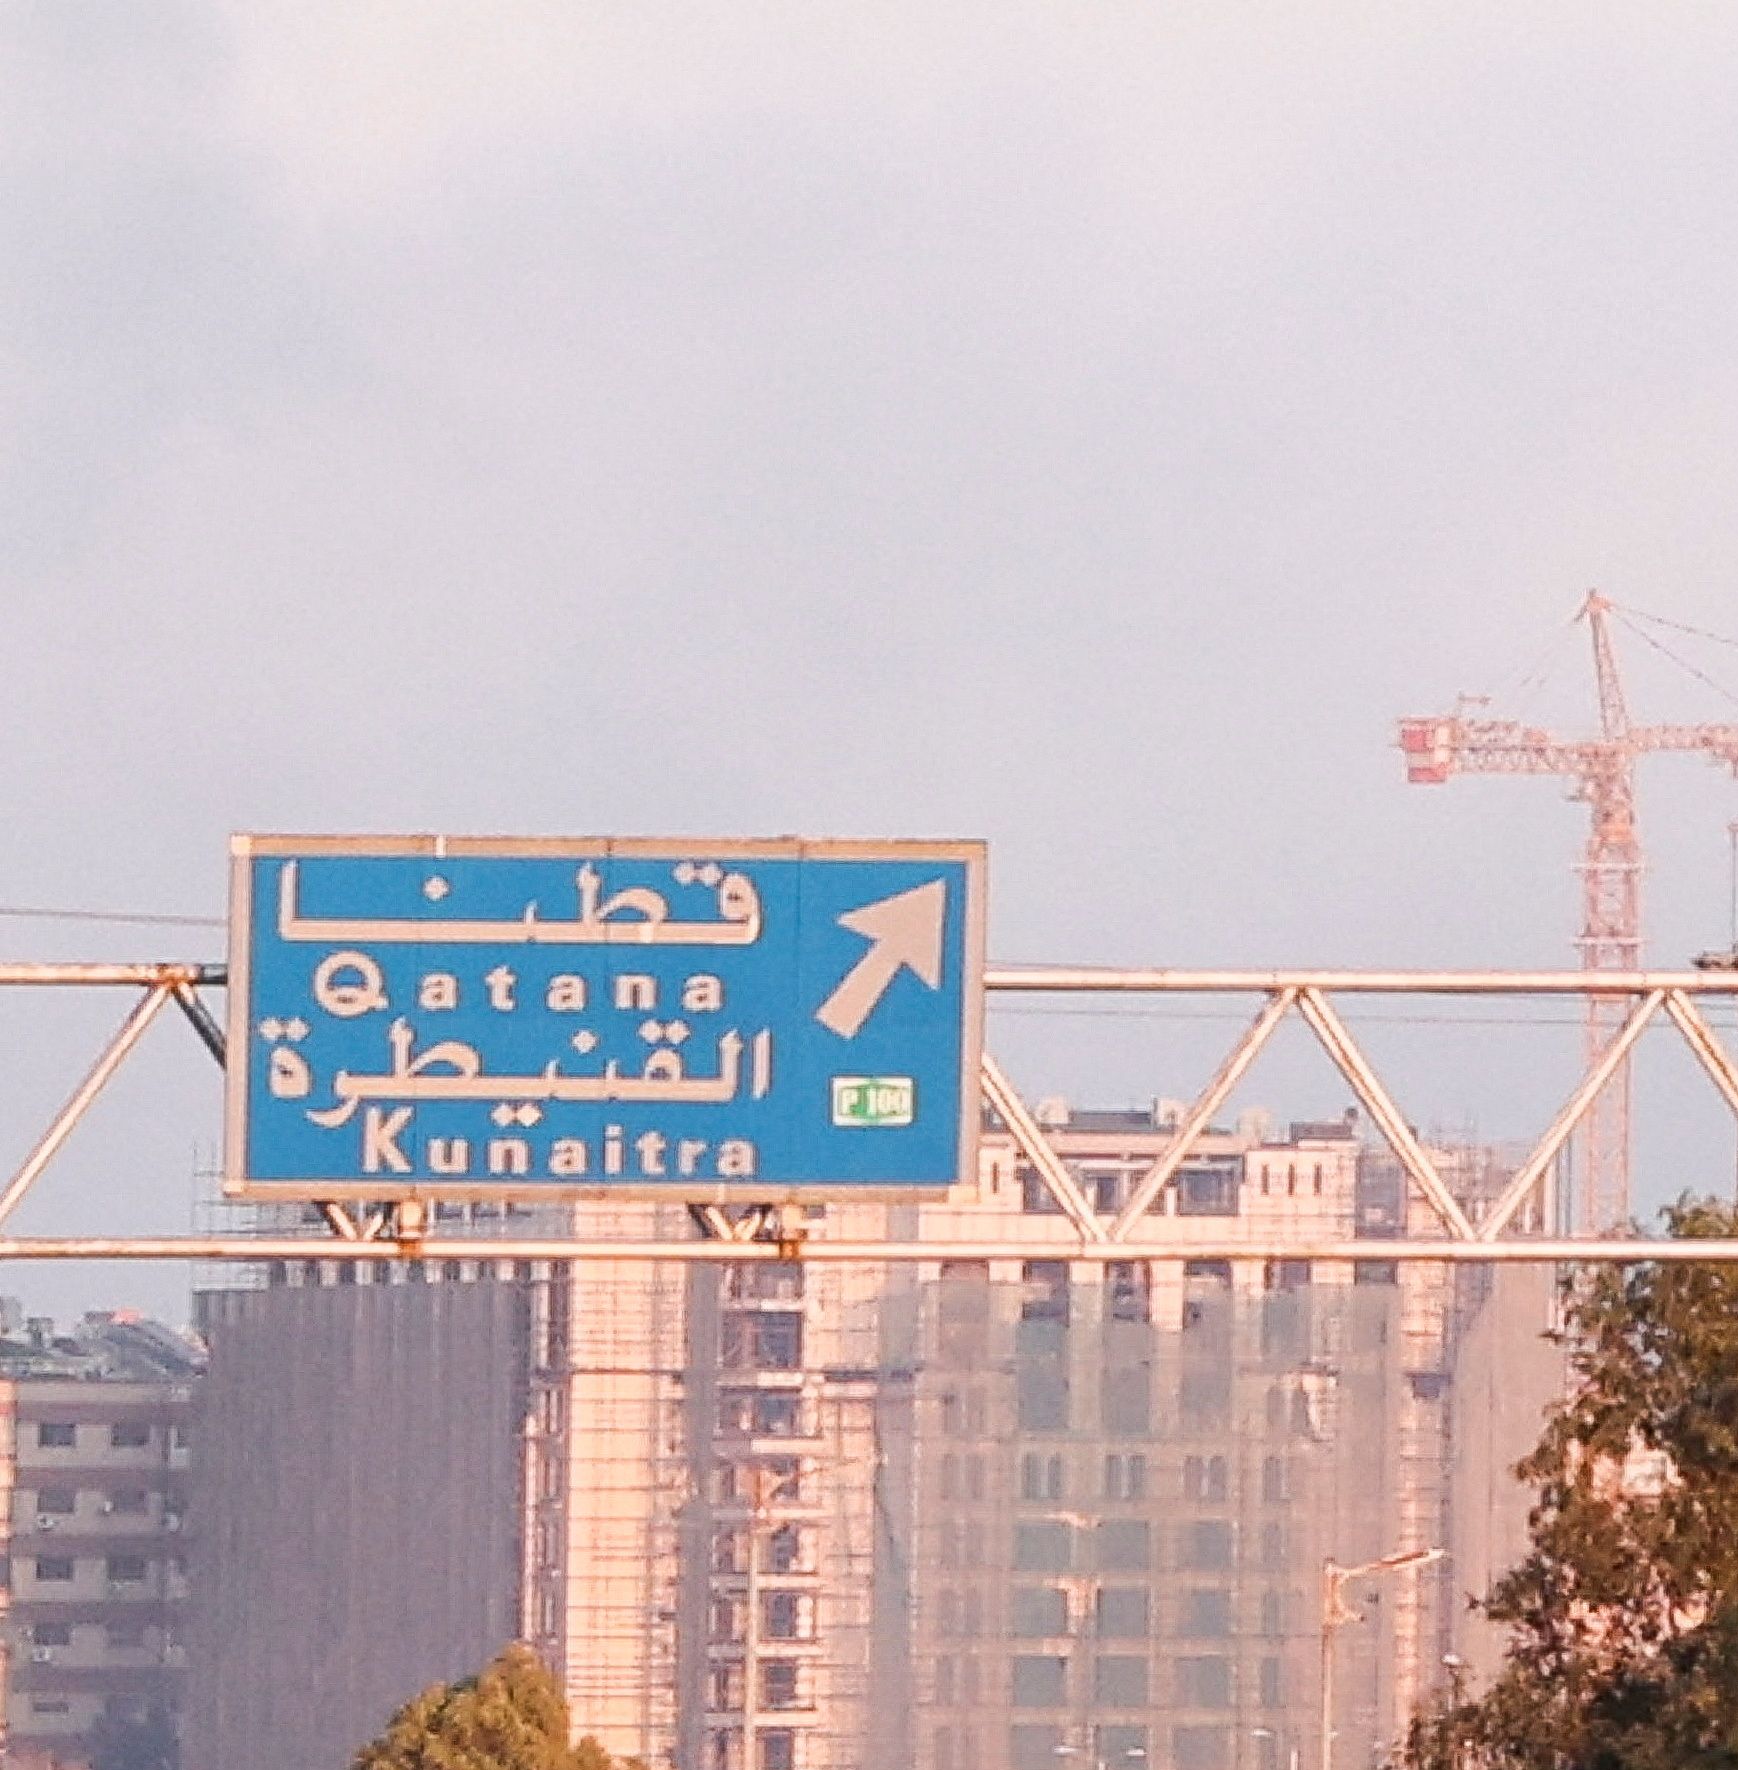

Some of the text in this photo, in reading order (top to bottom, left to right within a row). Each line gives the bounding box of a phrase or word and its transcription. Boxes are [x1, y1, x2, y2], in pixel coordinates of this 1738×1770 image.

[278, 859, 763, 943] قطنا
[314, 951, 725, 1016] Qatana
[259, 1017, 773, 1129] القنيطرة
[362, 1106, 758, 1176] Kunaitra
